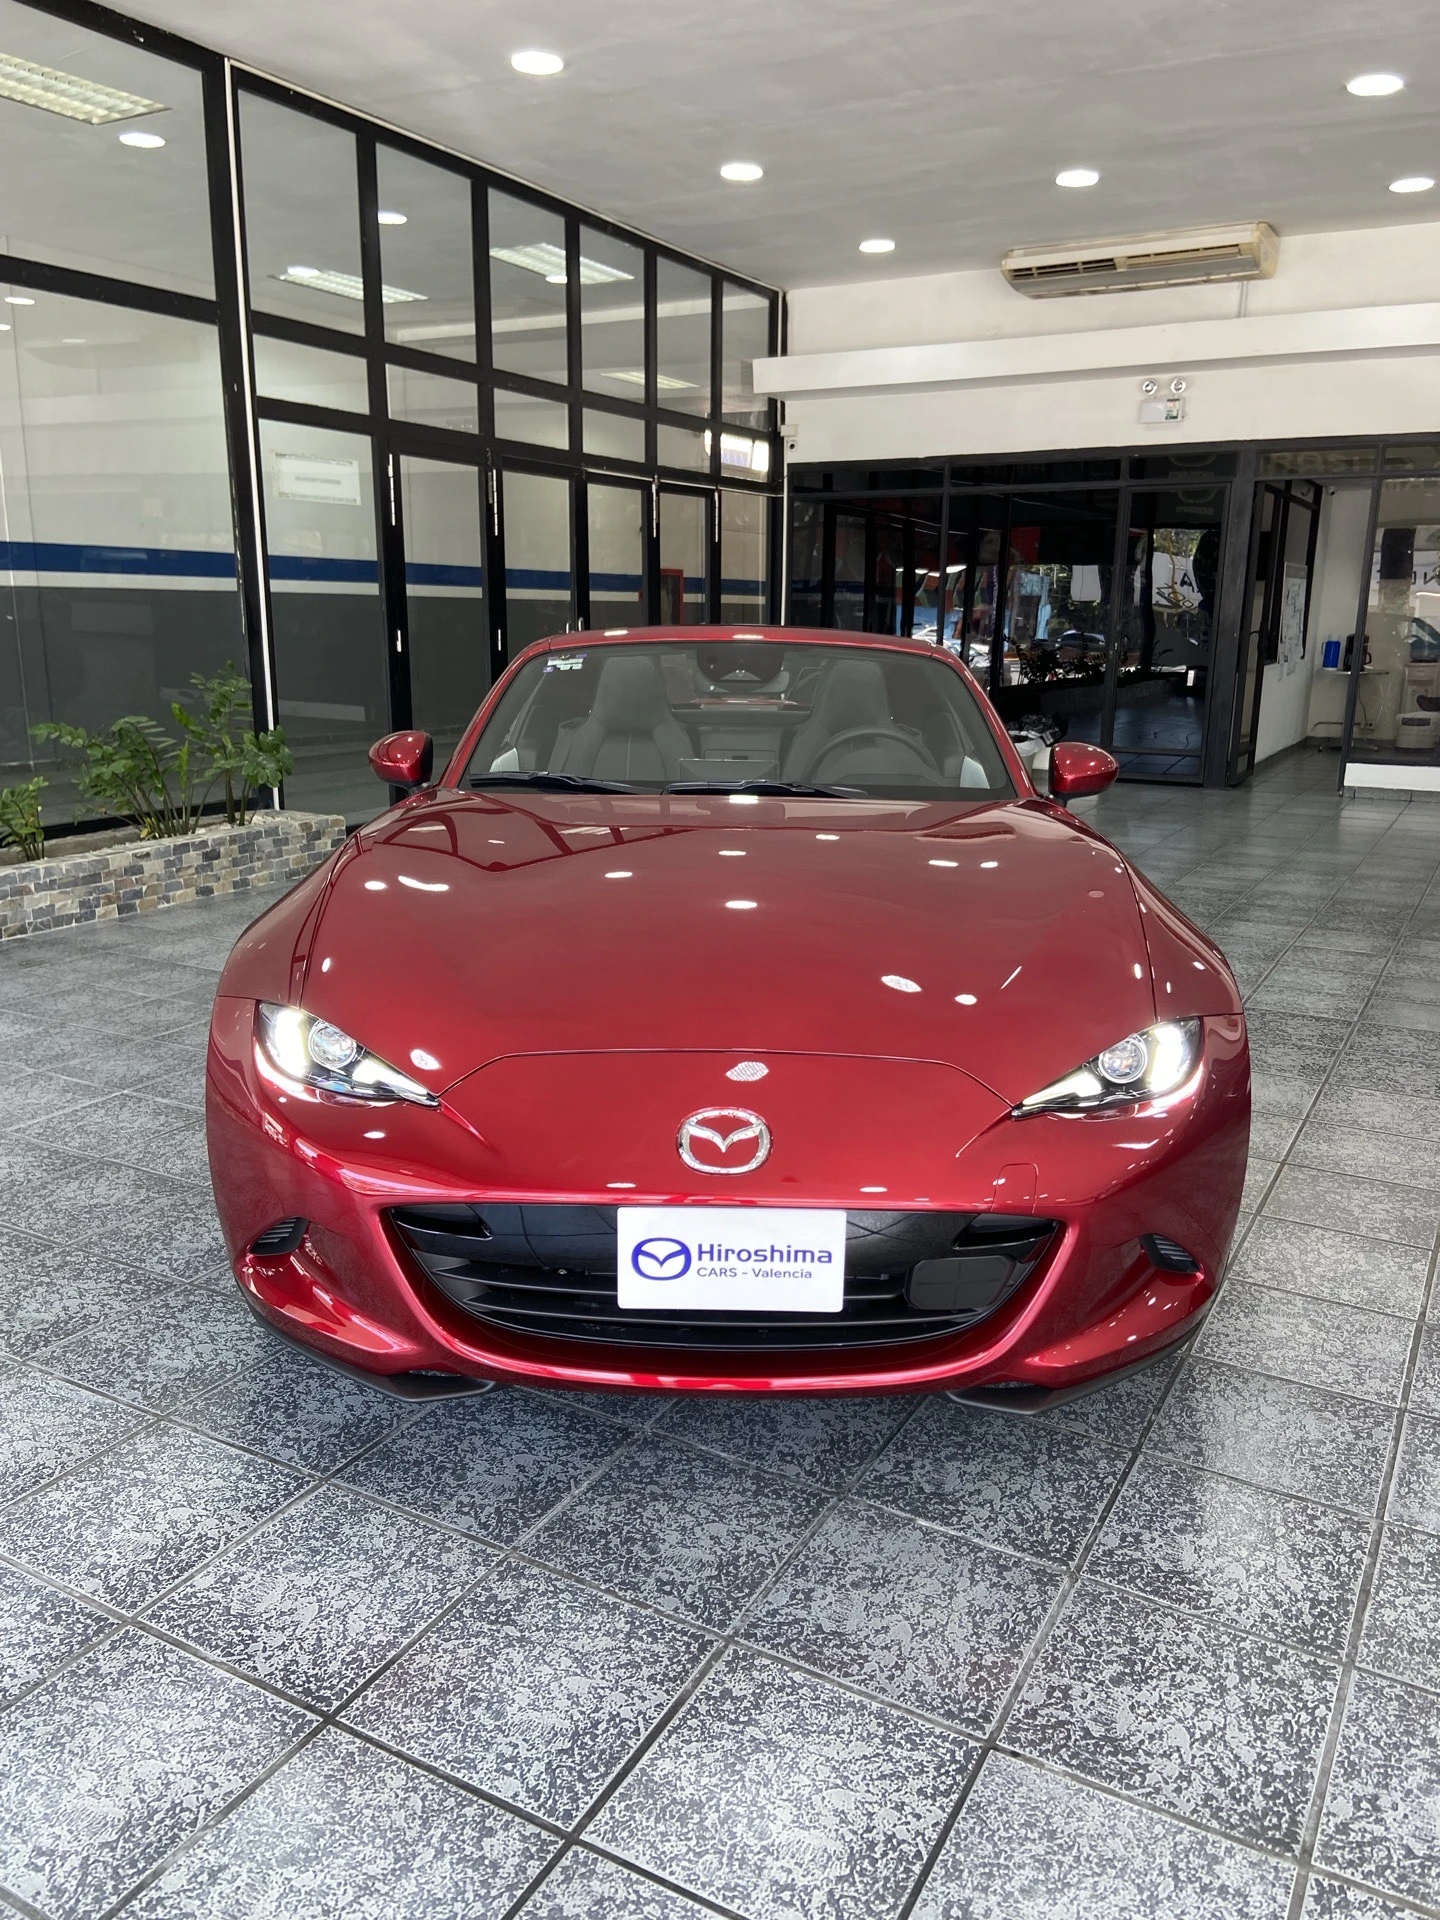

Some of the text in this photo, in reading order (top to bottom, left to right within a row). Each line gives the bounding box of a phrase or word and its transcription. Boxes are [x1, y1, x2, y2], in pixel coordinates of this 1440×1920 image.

[697, 1243, 833, 1264] Hiroshima
[696, 1267, 738, 1278] CARS
[751, 1267, 812, 1279] Valencia
